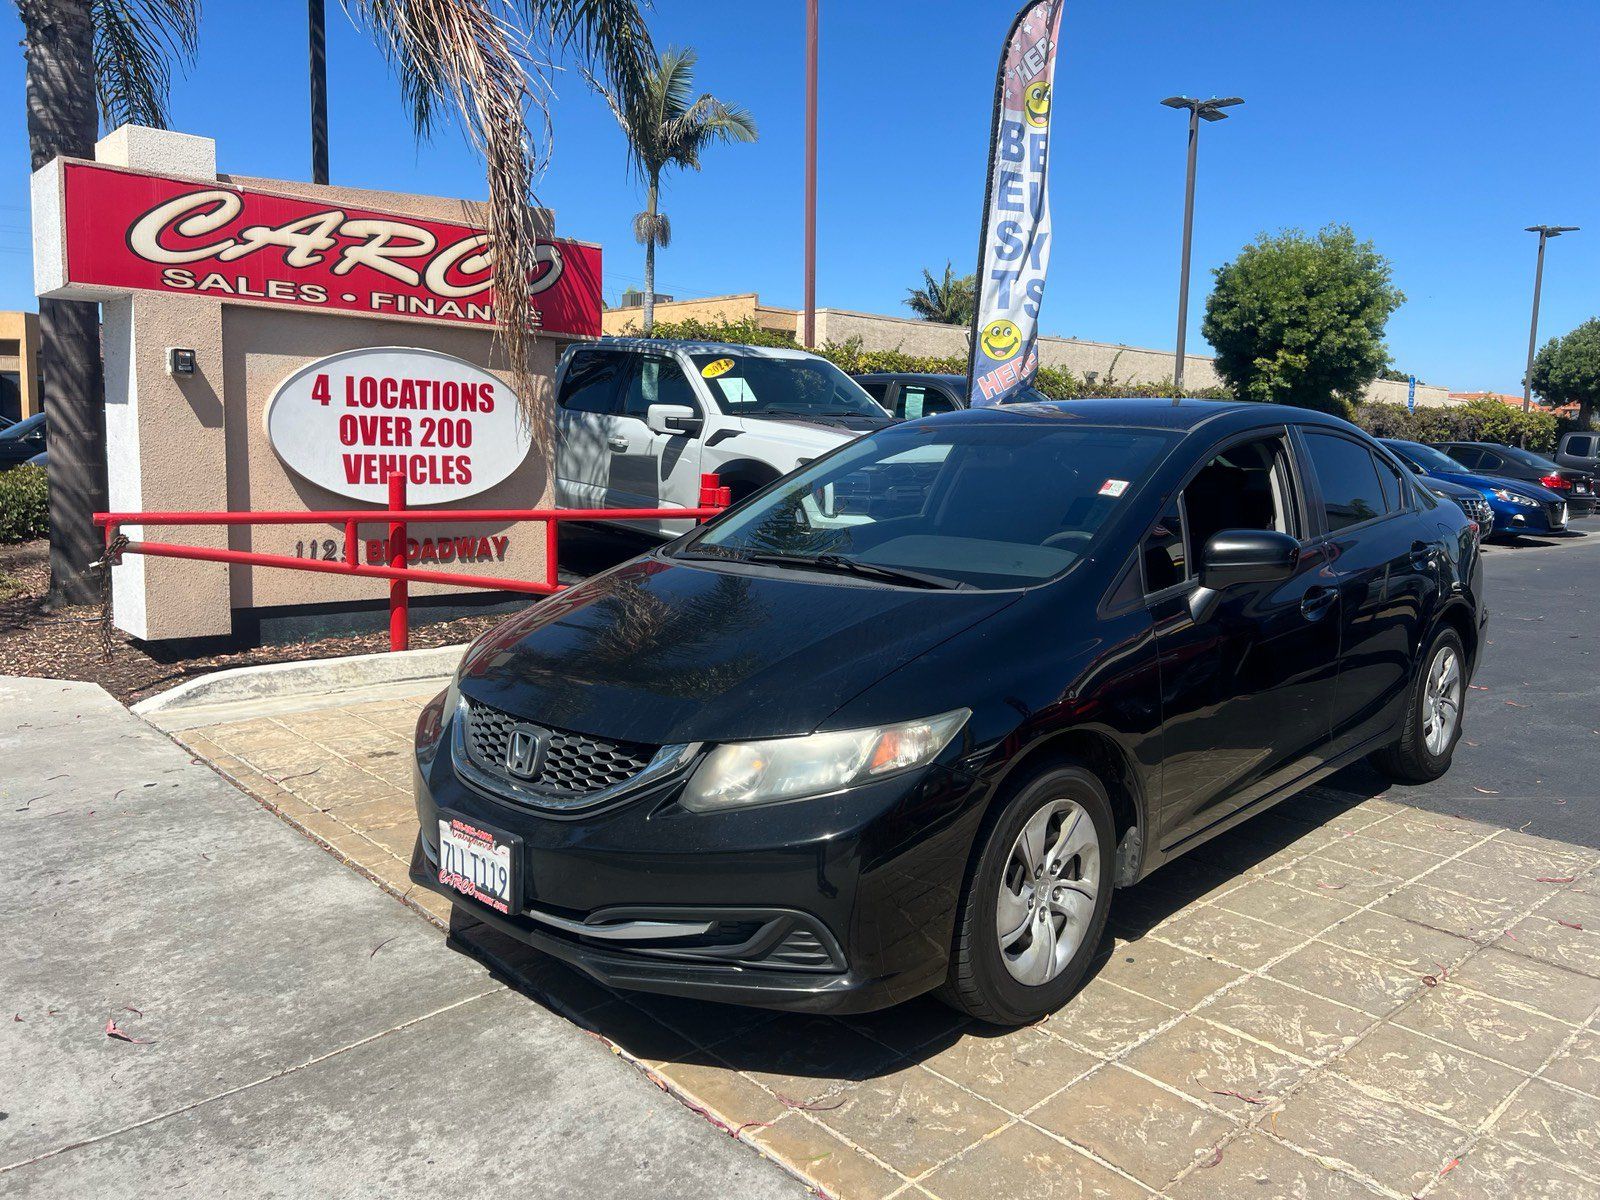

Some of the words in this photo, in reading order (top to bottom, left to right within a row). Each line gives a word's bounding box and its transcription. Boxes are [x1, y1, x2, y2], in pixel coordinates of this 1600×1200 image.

[991, 120, 1026, 310] BEST
[162, 267, 328, 303] SALES
[371, 291, 543, 329] FINANE
[311, 374, 332, 406] 4
[345, 376, 495, 413] LOCATIONS
[339, 414, 412, 446] OVER
[419, 417, 472, 448] 200
[342, 454, 472, 485] VEHICLES
[296, 539, 348, 561] 112
[365, 536, 508, 563] BOADWAY
